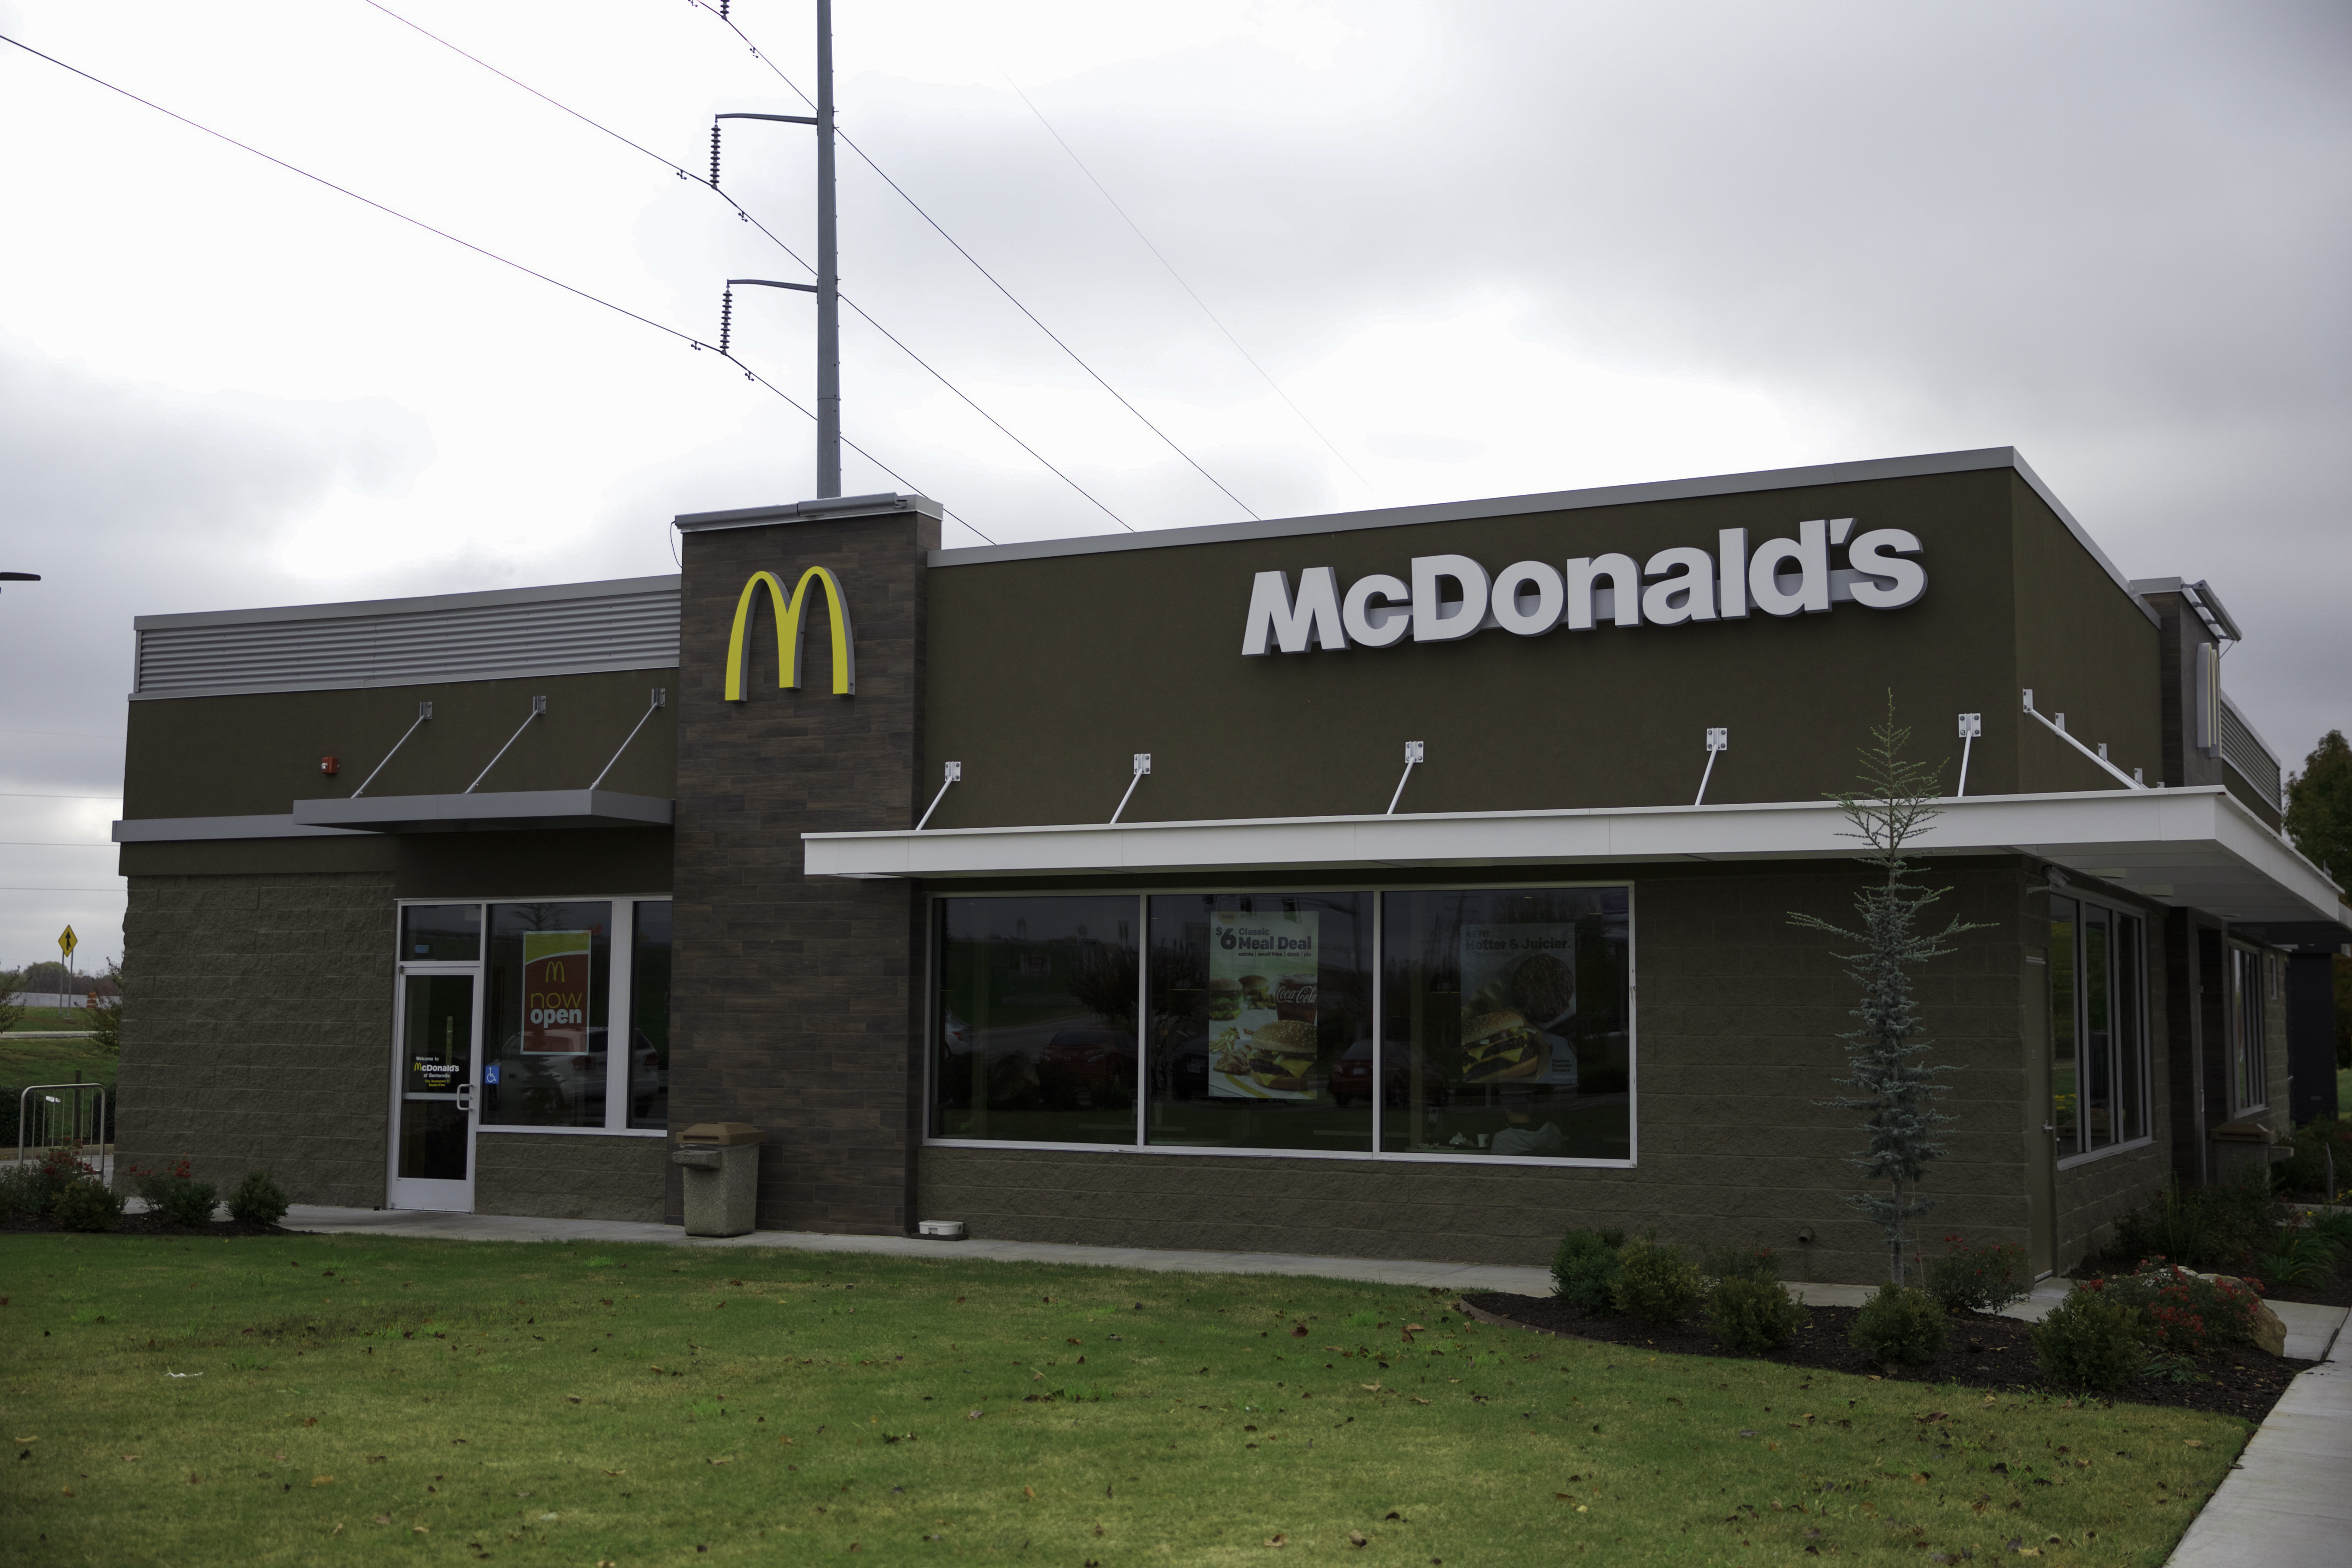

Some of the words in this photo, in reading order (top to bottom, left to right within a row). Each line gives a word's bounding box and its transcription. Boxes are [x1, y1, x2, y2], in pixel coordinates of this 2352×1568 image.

[1241, 518, 1928, 656] McDonald's
[1239, 927, 1270, 935] Classic
[1238, 936, 1274, 949] Meal
[1278, 936, 1311, 949] Deal
[1465, 939, 1507, 950] Hotter
[1509, 938, 1519, 949] &
[531, 992, 582, 1008] now
[530, 1008, 582, 1029] open
[414, 1062, 459, 1072] McDonald's
